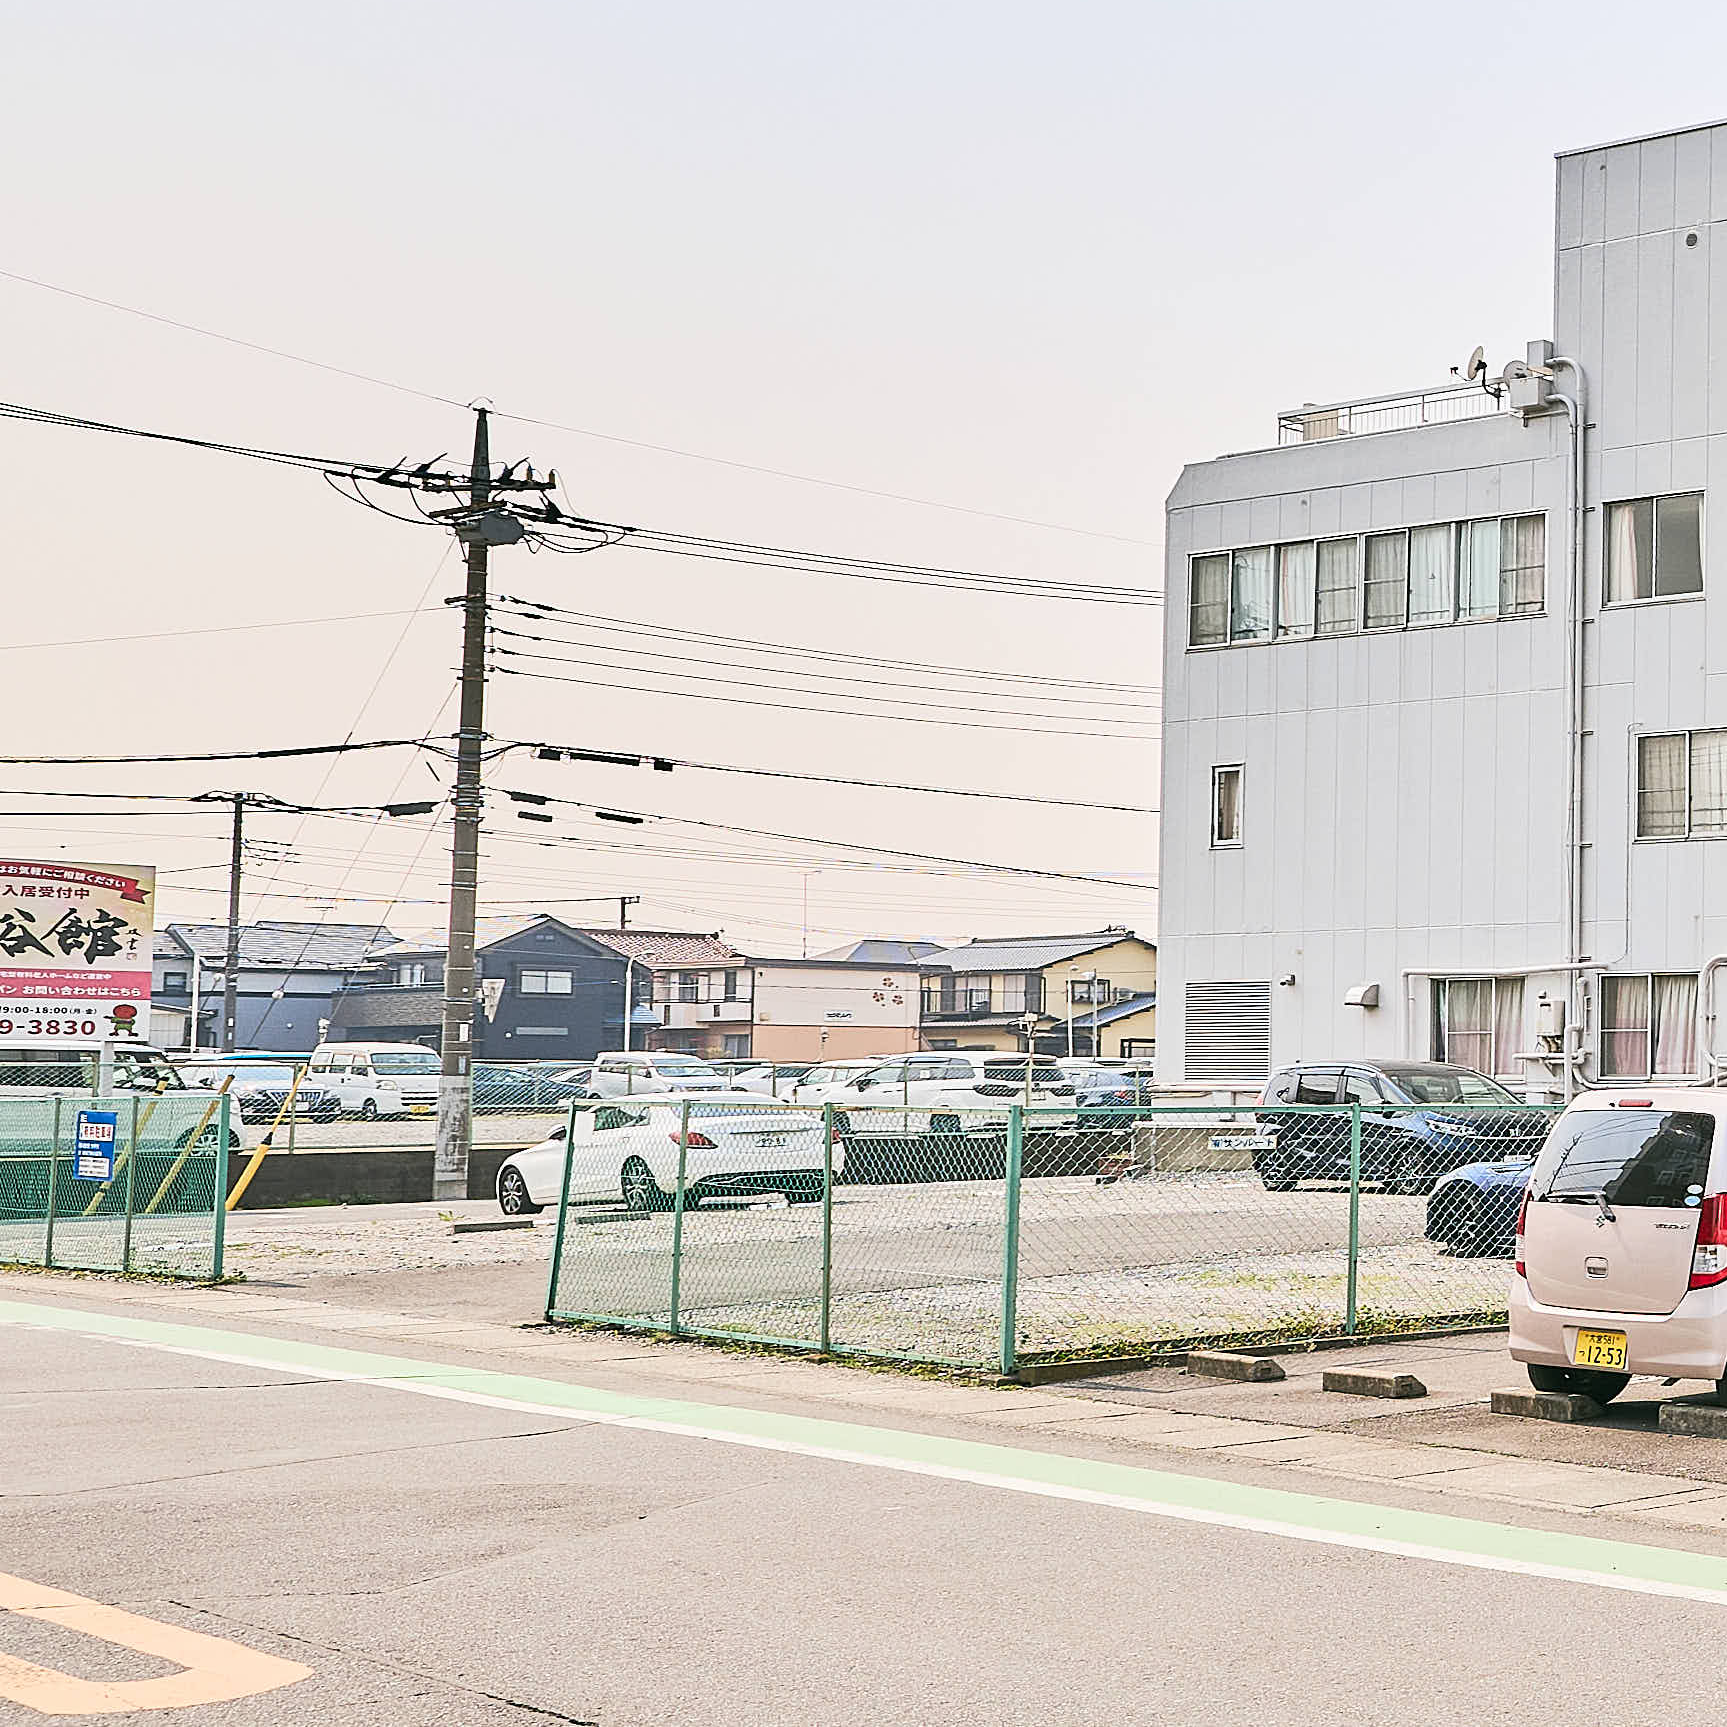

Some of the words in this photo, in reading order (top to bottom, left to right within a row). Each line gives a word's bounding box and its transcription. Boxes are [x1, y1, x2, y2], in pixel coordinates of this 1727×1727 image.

[2, 885, 90, 899] 入居受付中
[22, 985, 142, 997] お問い合わせはこちら
